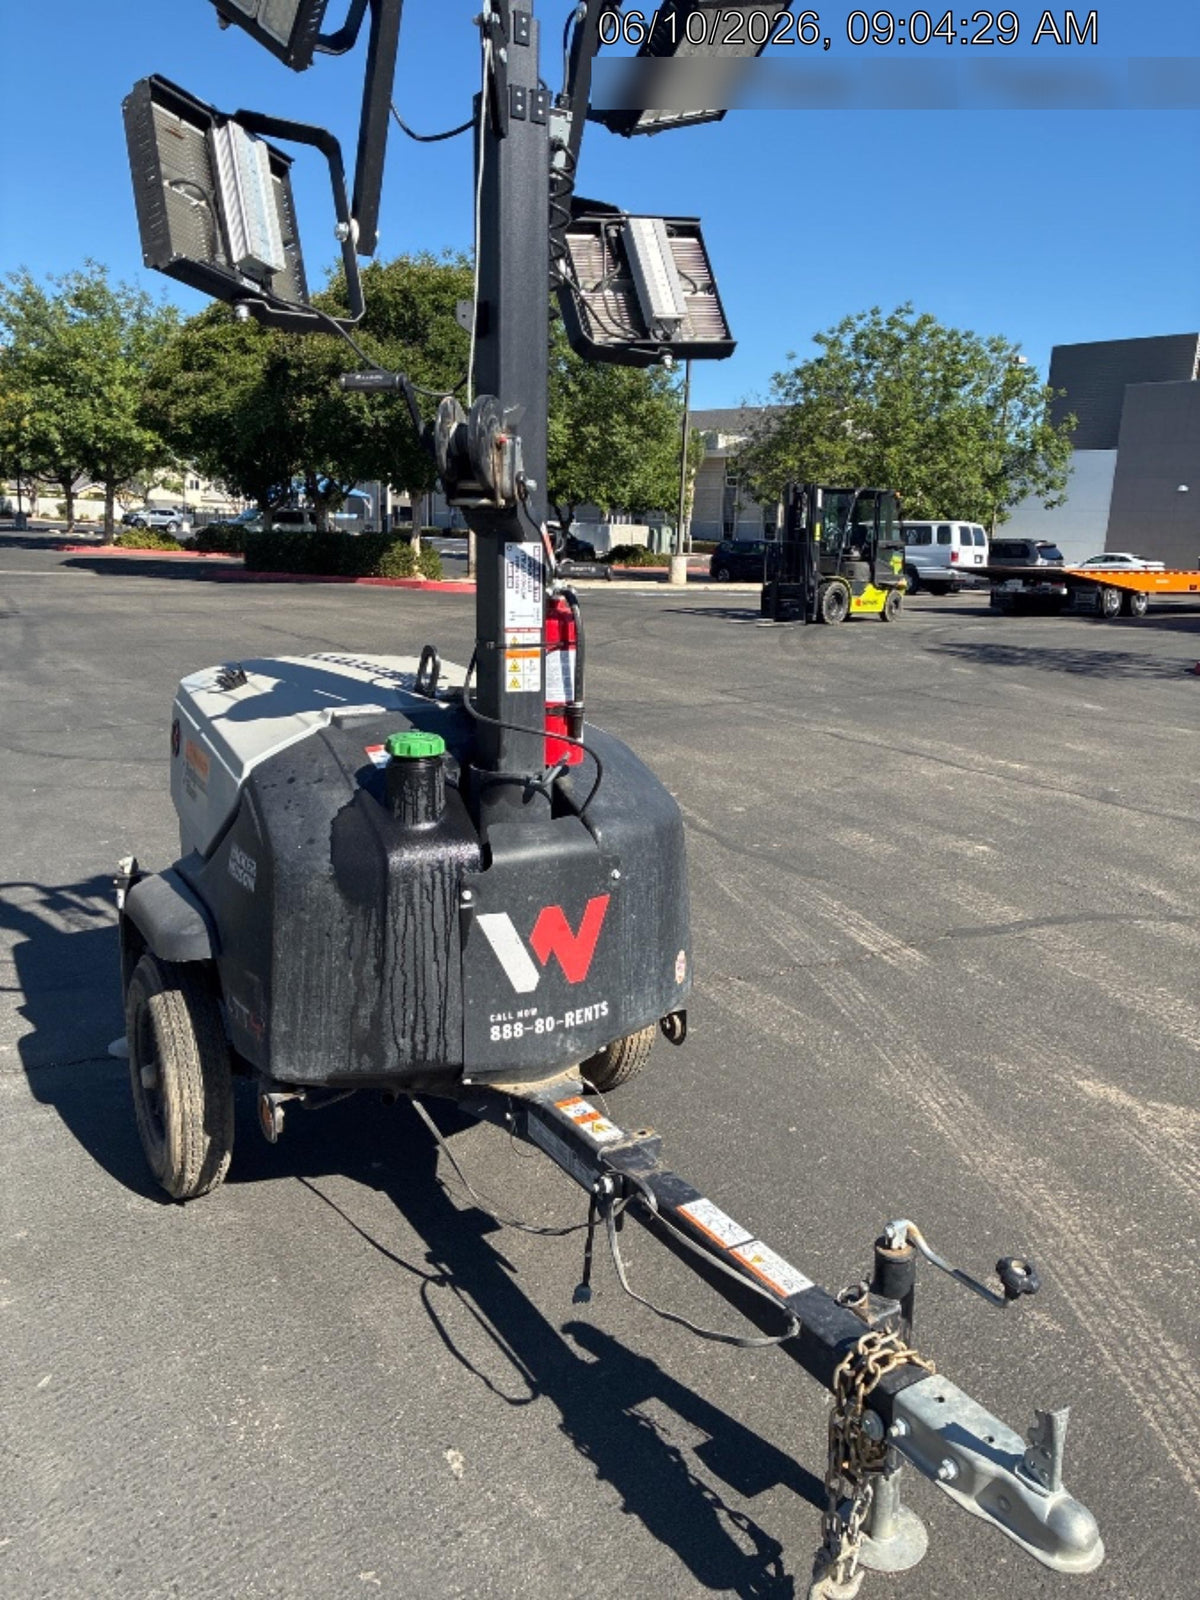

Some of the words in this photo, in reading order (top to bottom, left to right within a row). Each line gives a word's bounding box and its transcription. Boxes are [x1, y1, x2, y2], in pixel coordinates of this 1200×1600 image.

[490, 1011, 514, 1022] CALL
[517, 1007, 538, 1018] NOW
[490, 1001, 609, 1041] 888-80-RENTS
